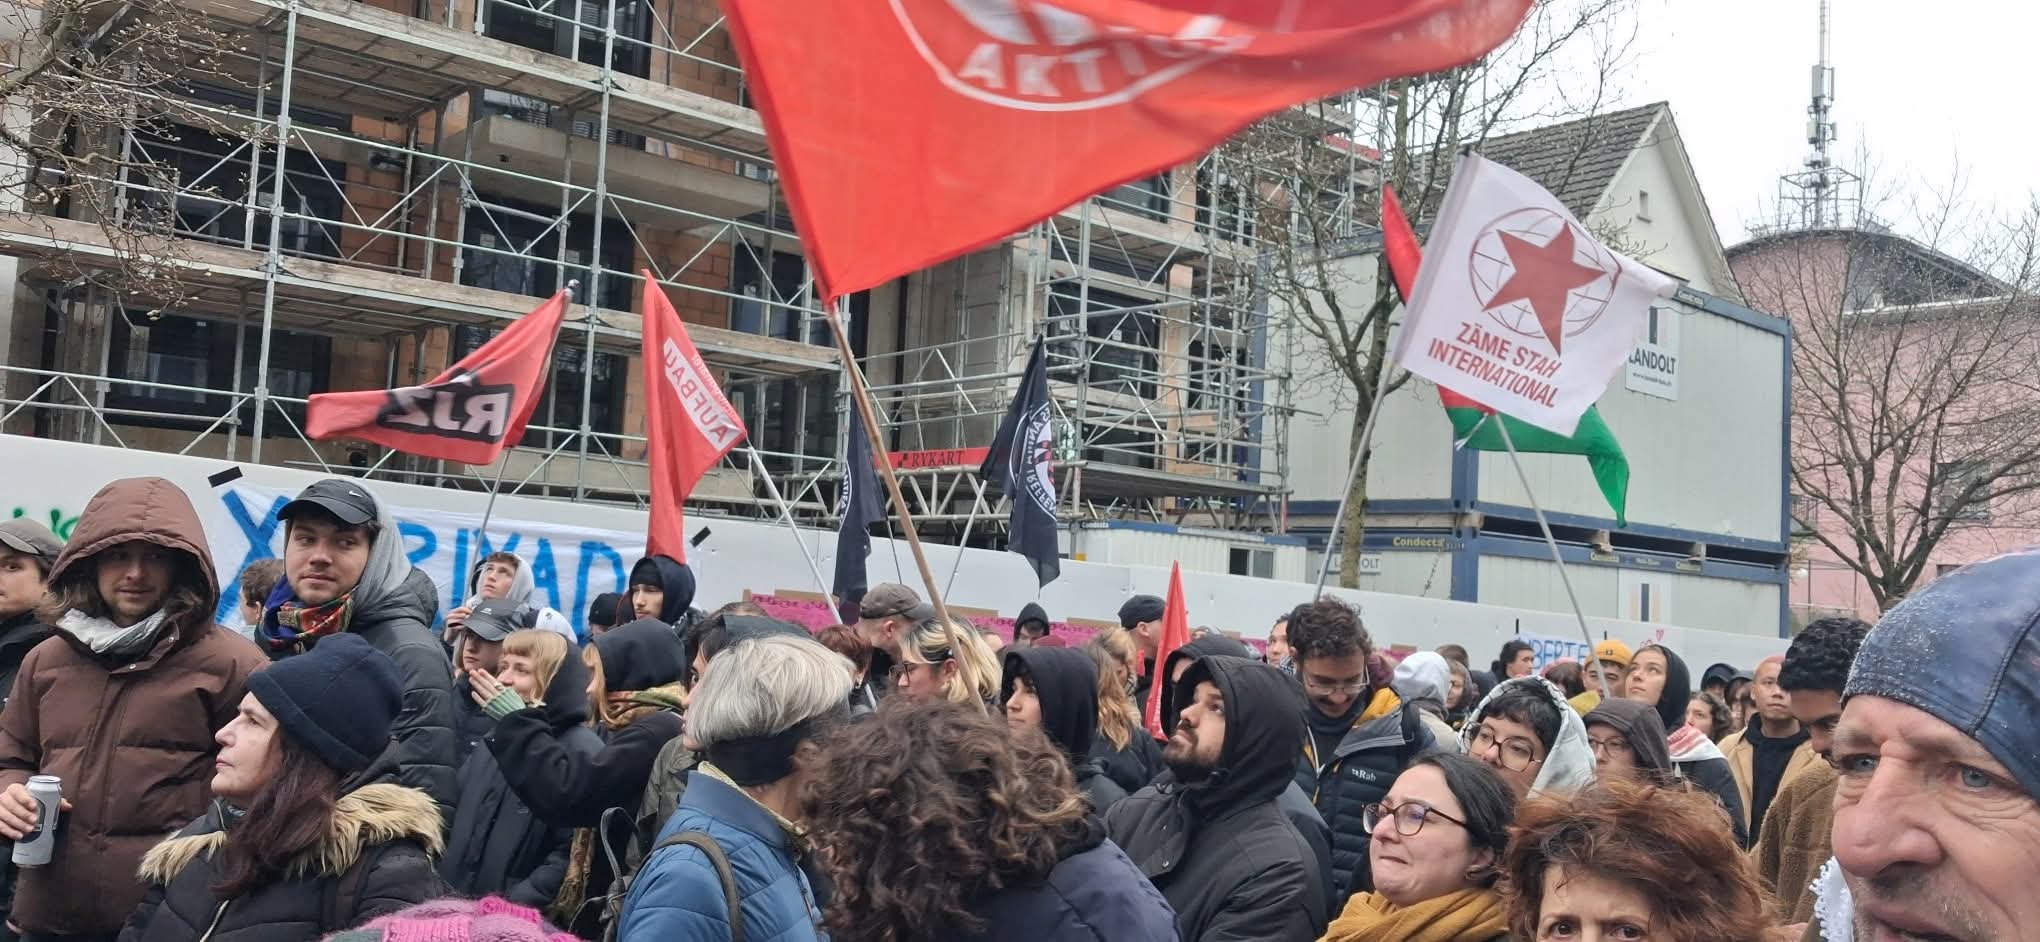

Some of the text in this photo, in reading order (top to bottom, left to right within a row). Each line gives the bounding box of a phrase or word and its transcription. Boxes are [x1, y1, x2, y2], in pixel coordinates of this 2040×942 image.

[1456, 321, 1562, 378] ZÄME STAH
[1427, 337, 1559, 408] INTERNATIONAL
[911, 450, 966, 468] RYKART
[1360, 769, 1376, 782] Rab
